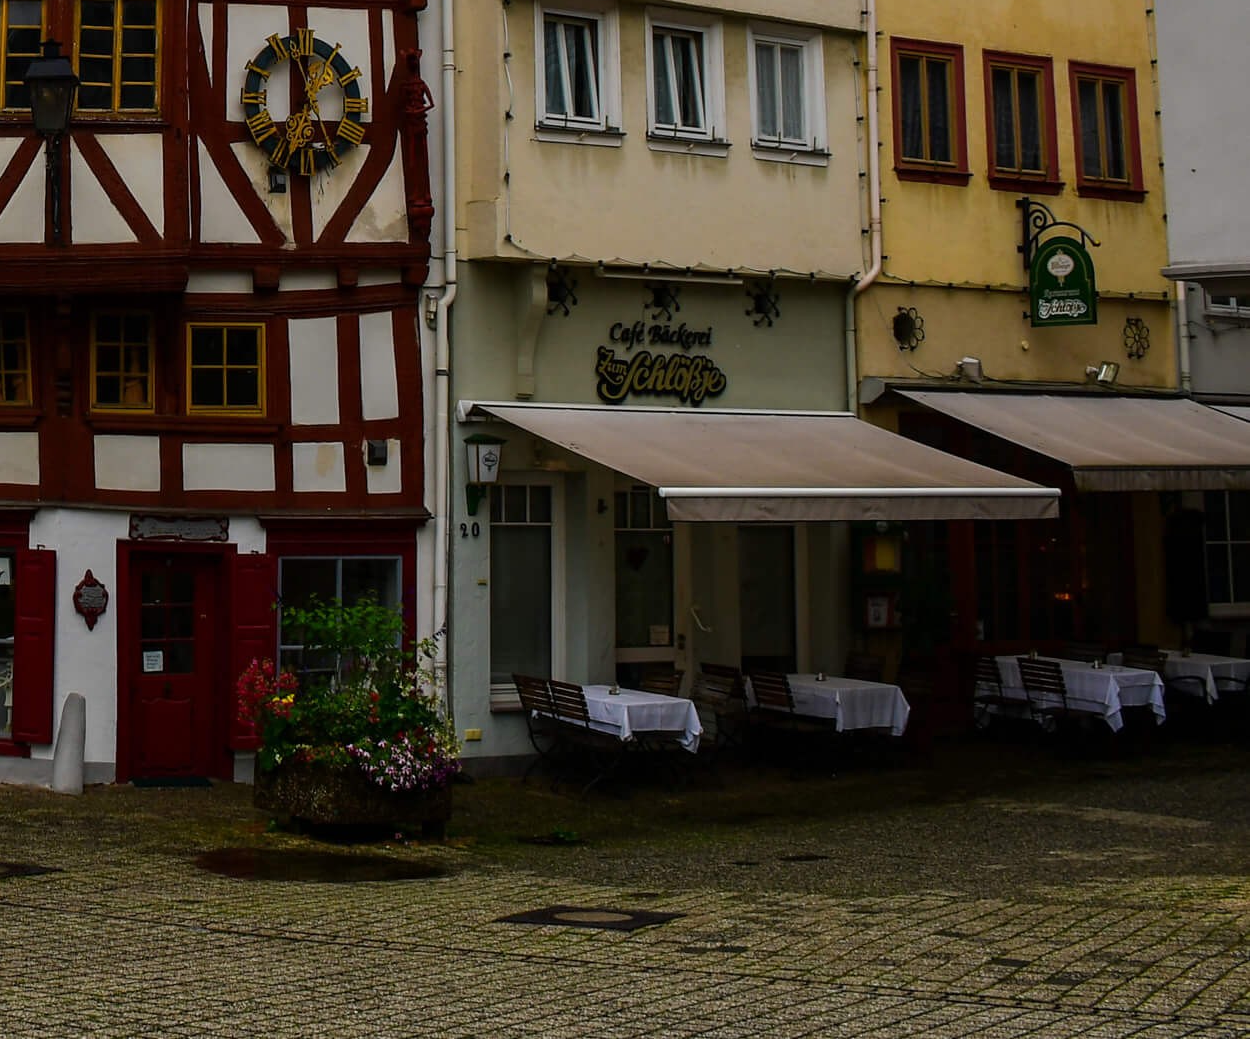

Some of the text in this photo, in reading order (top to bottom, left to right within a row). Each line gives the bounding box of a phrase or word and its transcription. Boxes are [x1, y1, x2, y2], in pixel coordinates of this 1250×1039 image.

[609, 321, 712, 350] Café Bäckerei
[597, 346, 630, 384] Zum
[460, 522, 480, 538] 20
